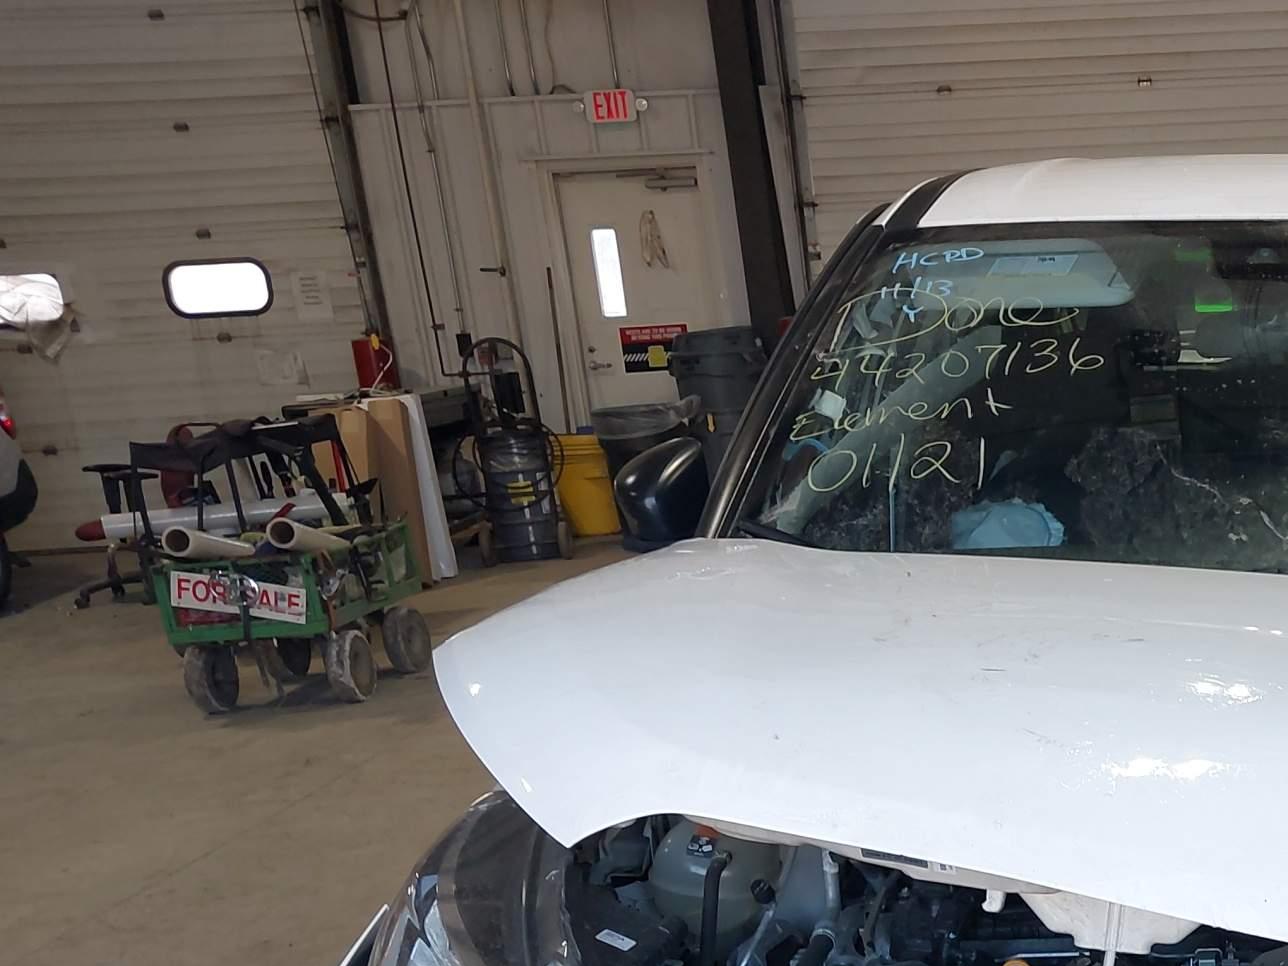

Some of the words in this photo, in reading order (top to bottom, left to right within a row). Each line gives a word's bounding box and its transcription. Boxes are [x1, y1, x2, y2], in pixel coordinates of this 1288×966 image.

[592, 90, 628, 120] EXIT
[828, 288, 1079, 352] Done
[811, 338, 1105, 391] 44207136
[789, 388, 1013, 441] Element
[807, 434, 986, 492] 01/21
[176, 577, 227, 605] FOR
